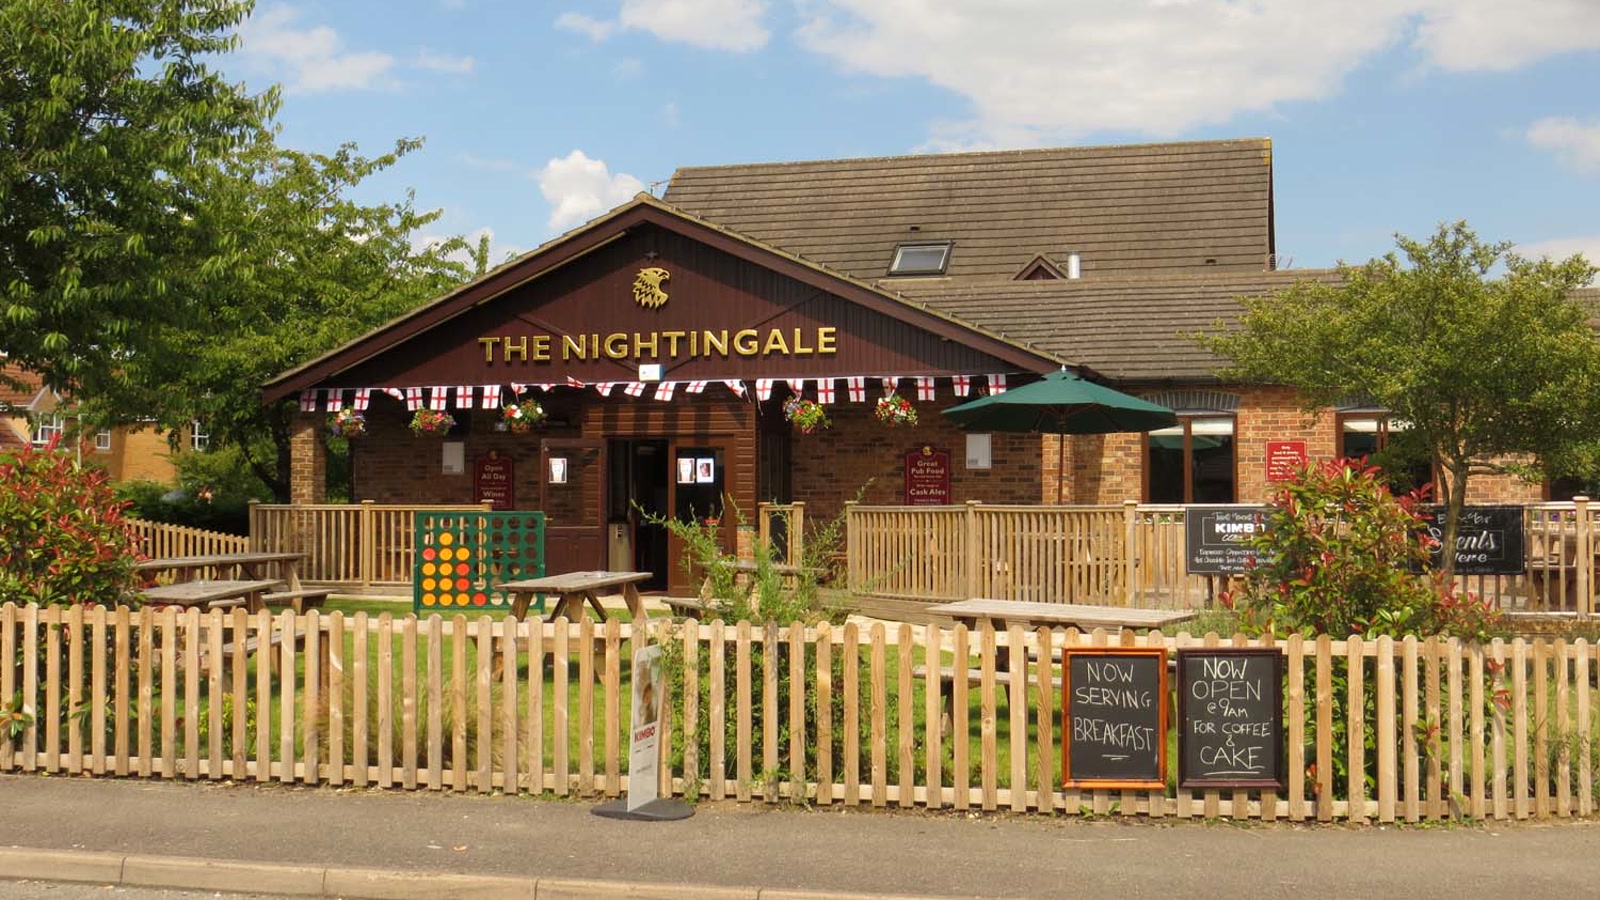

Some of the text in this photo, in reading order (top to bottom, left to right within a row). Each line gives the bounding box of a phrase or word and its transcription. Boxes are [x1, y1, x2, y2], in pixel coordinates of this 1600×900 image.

[478, 327, 837, 362] THE NIGHTINGALE
[910, 488, 946, 496] Cask Ales
[1087, 662, 1134, 684] NOW
[1203, 657, 1248, 680] NOW
[1075, 687, 1152, 709] SERVING
[1192, 679, 1260, 701] OPEN
[1074, 716, 1154, 752] BREAKFAST
[1194, 720, 1271, 738] FOR COFFEE
[1225, 734, 1236, 747] &
[1200, 745, 1265, 770] CAKE
